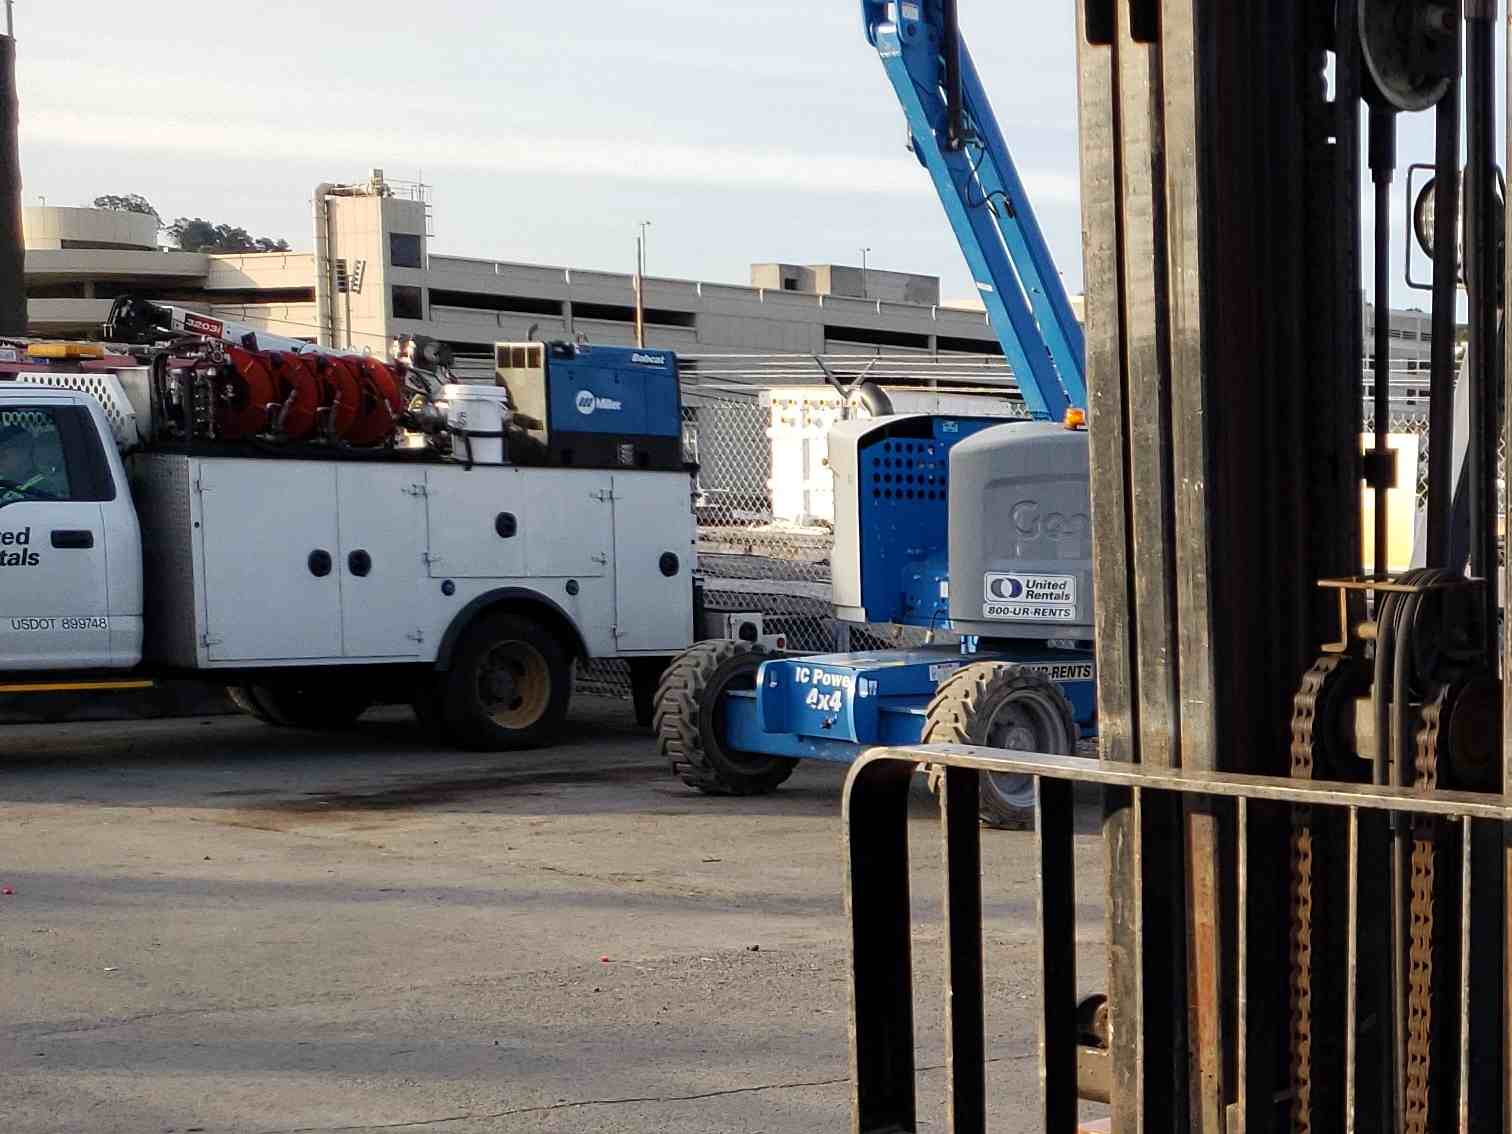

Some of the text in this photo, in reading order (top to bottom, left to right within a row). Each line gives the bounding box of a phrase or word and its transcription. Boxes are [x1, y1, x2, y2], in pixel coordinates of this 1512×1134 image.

[632, 353, 664, 365] Bobcat
[0, 527, 30, 546] ed
[1026, 579, 1067, 591] United
[1026, 591, 1072, 601] Rentals
[987, 606, 1072, 617] 800-UR-RENTS
[11, 618, 107, 630] USDOT 899748
[812, 669, 851, 688] Powe
[806, 688, 842, 711] 4x4
